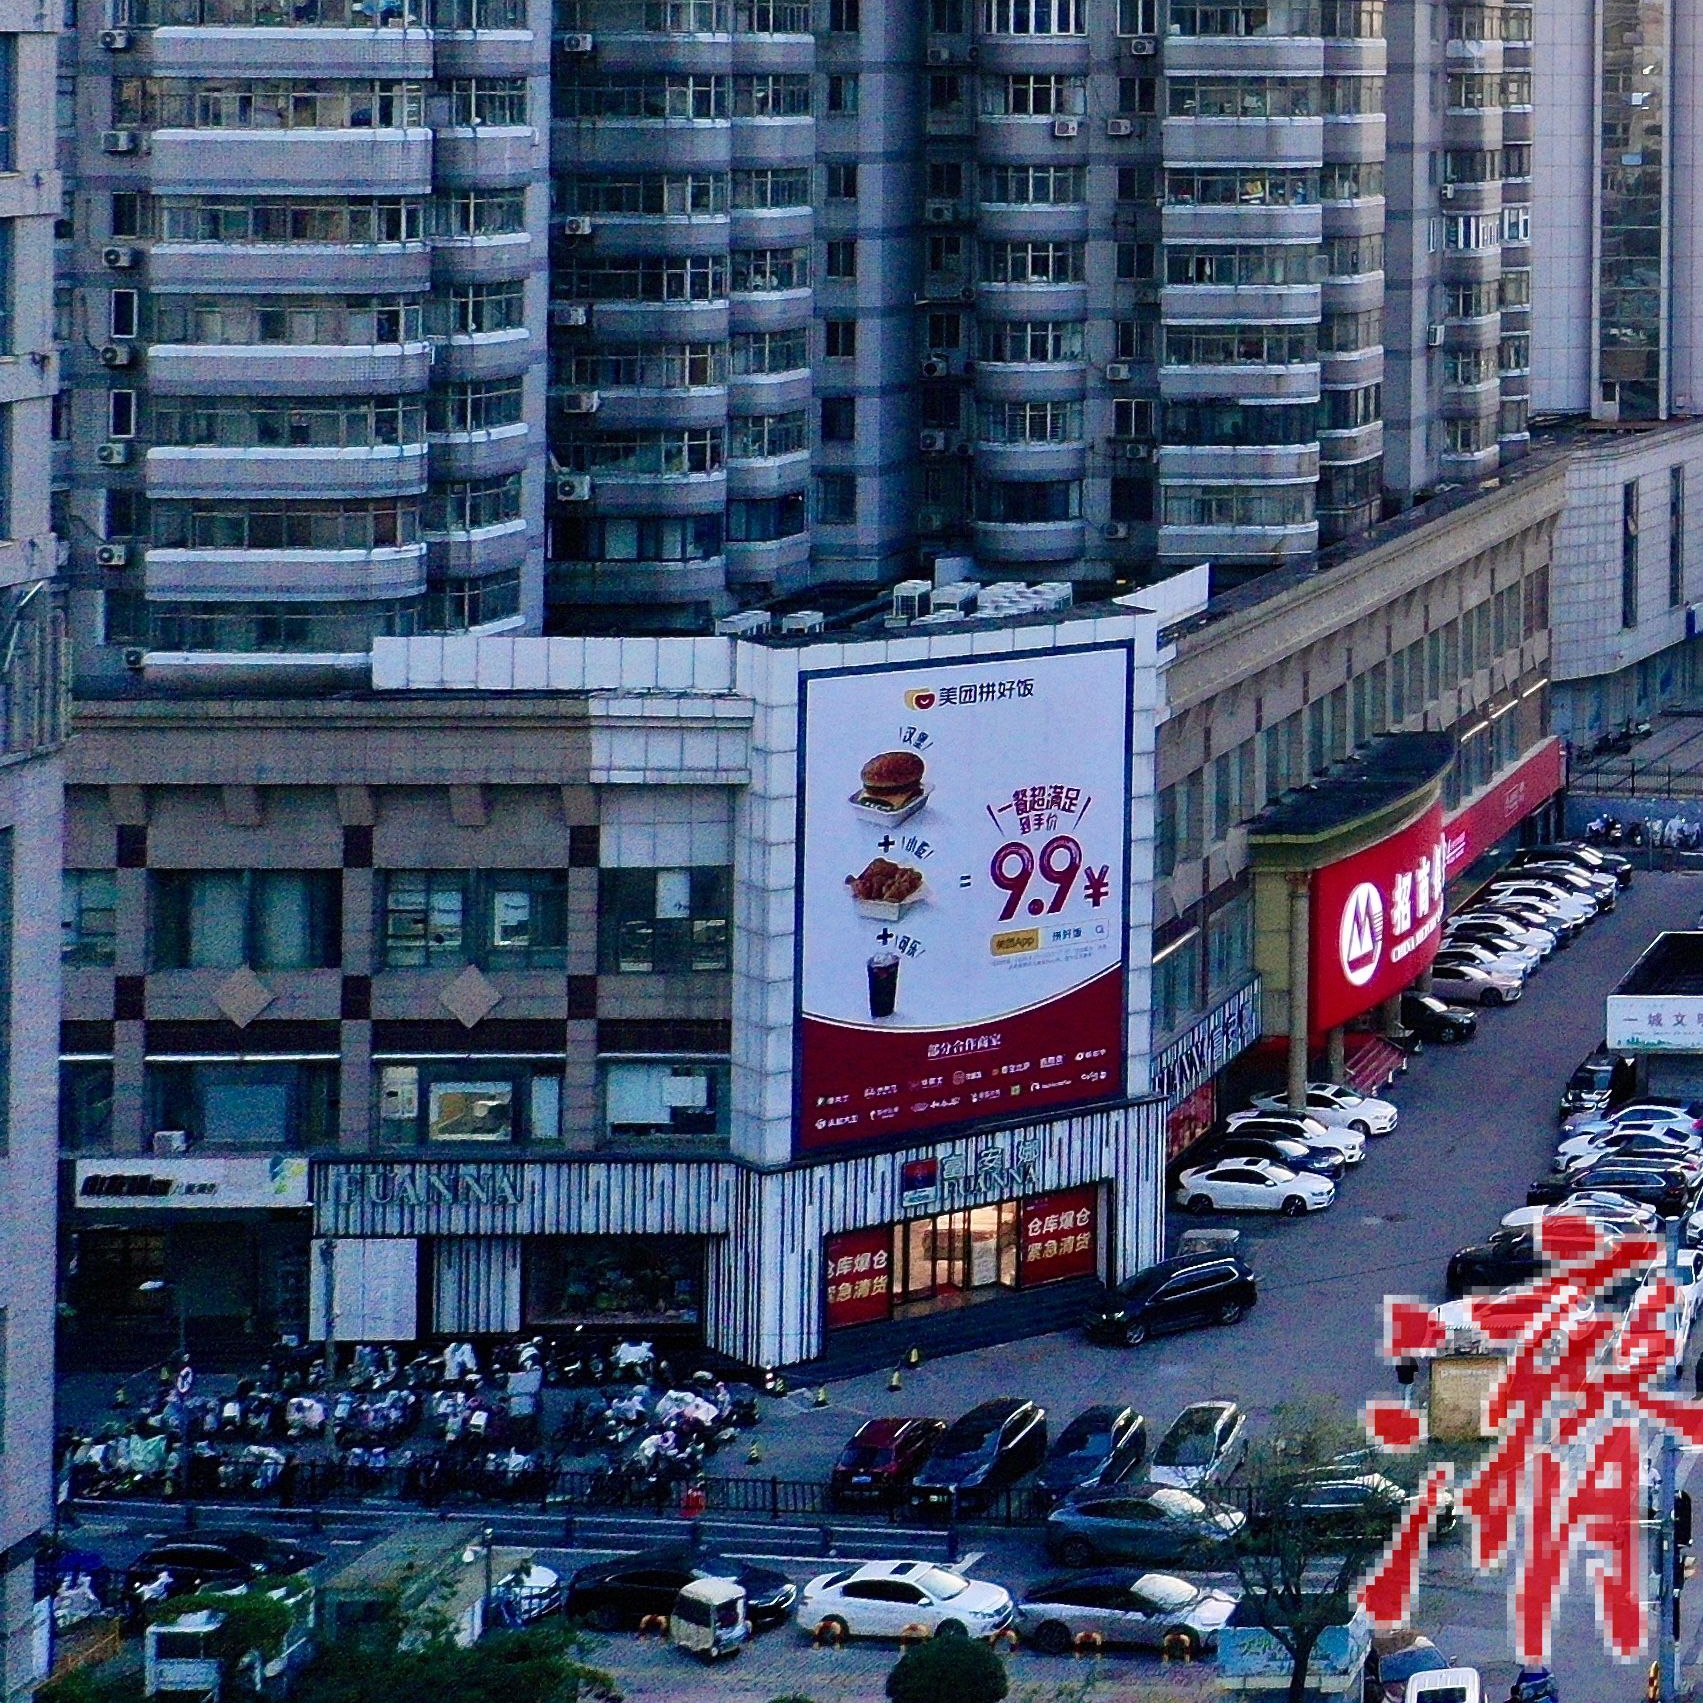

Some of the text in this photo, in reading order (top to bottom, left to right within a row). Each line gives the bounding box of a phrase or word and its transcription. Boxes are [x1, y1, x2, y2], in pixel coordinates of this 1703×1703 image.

[938, 678, 1035, 707] 美团拼好饭
[997, 785, 1082, 815] 一餐超满足
[1019, 813, 1059, 836] 到手价
[340, 1171, 523, 1206] FUANNA
[1026, 1206, 1092, 1237] 仓库爆仓
[1026, 1232, 1092, 1263] 紧急清货
